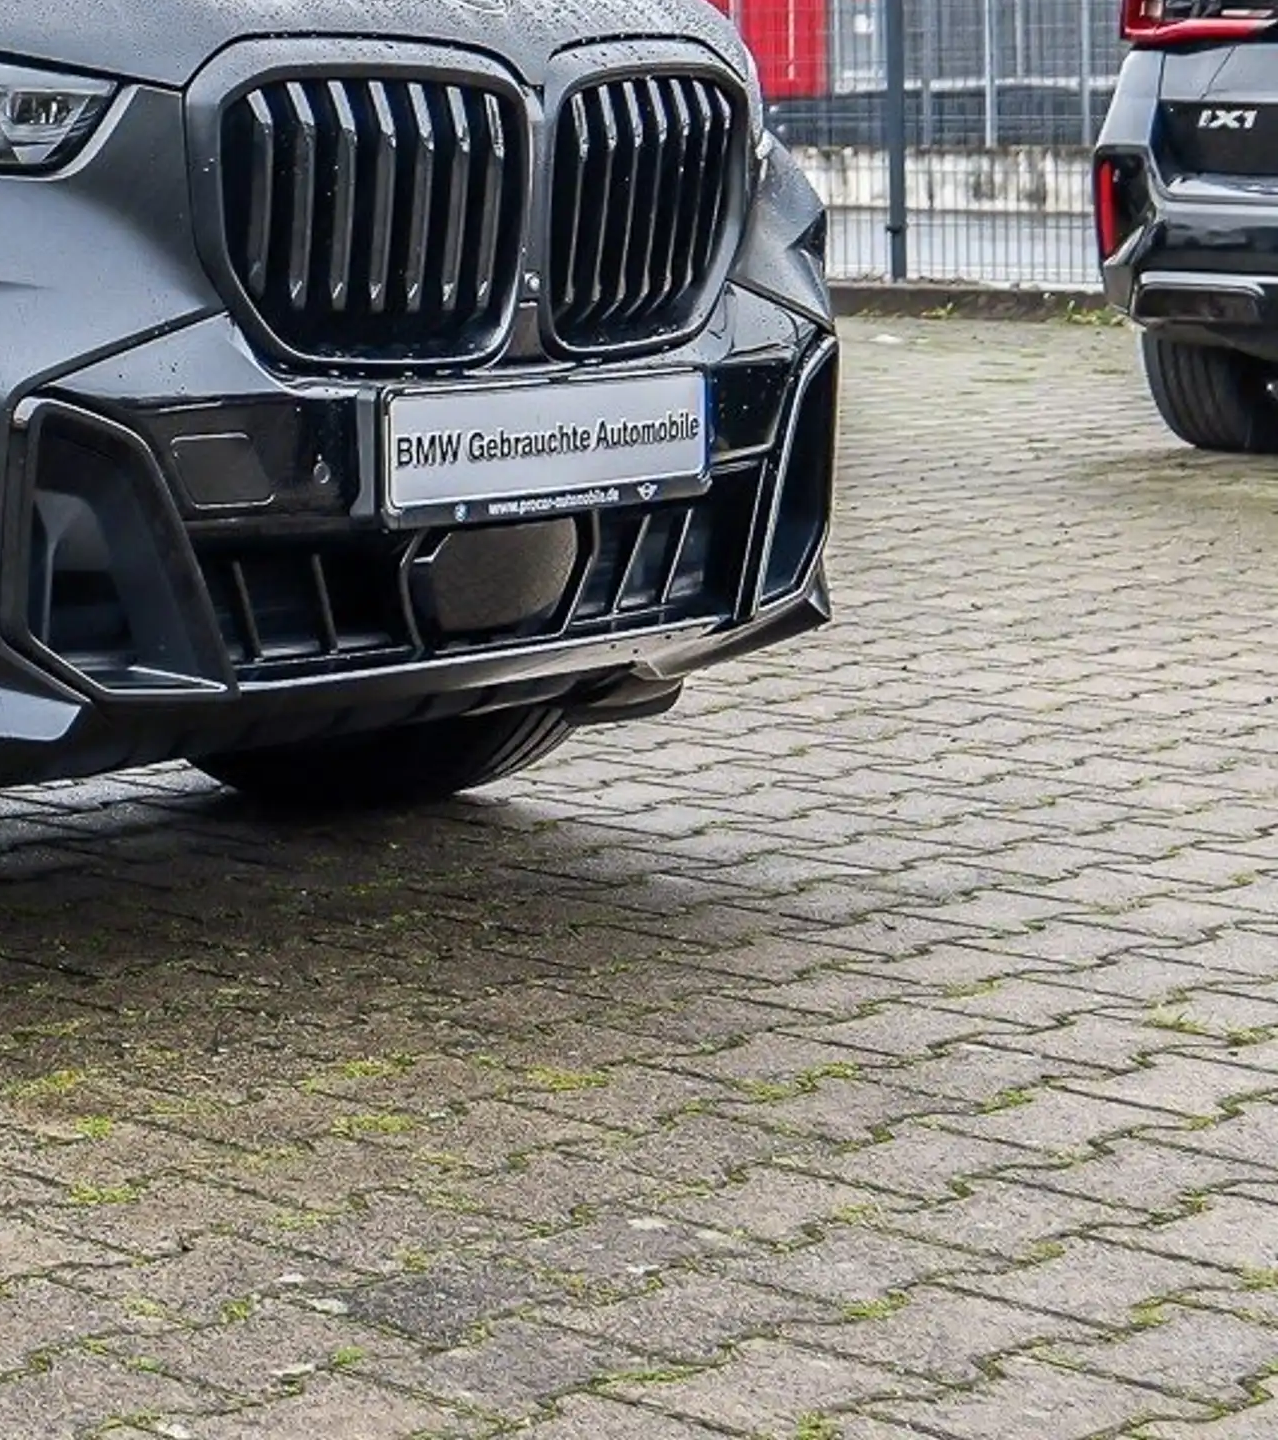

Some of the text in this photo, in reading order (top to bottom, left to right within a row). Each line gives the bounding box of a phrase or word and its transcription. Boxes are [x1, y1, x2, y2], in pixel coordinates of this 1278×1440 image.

[397, 411, 699, 467] BMW Gebrauchte Automobile
